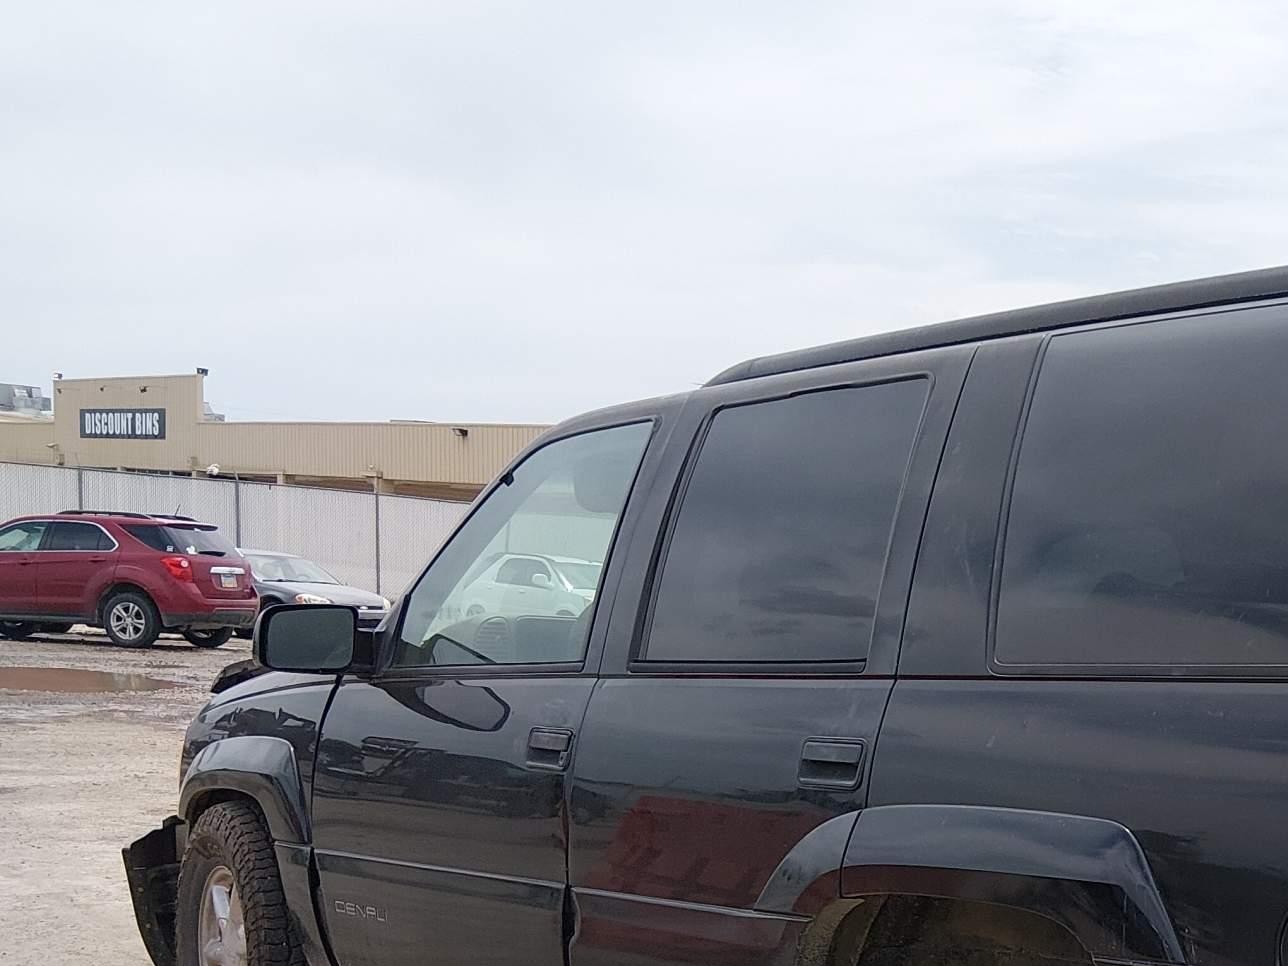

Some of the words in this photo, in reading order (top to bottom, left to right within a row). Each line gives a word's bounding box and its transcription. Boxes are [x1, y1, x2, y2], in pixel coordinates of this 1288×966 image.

[84, 412, 133, 435] DISCOUNT
[135, 412, 160, 436] BINS
[334, 900, 389, 922] DENALI
